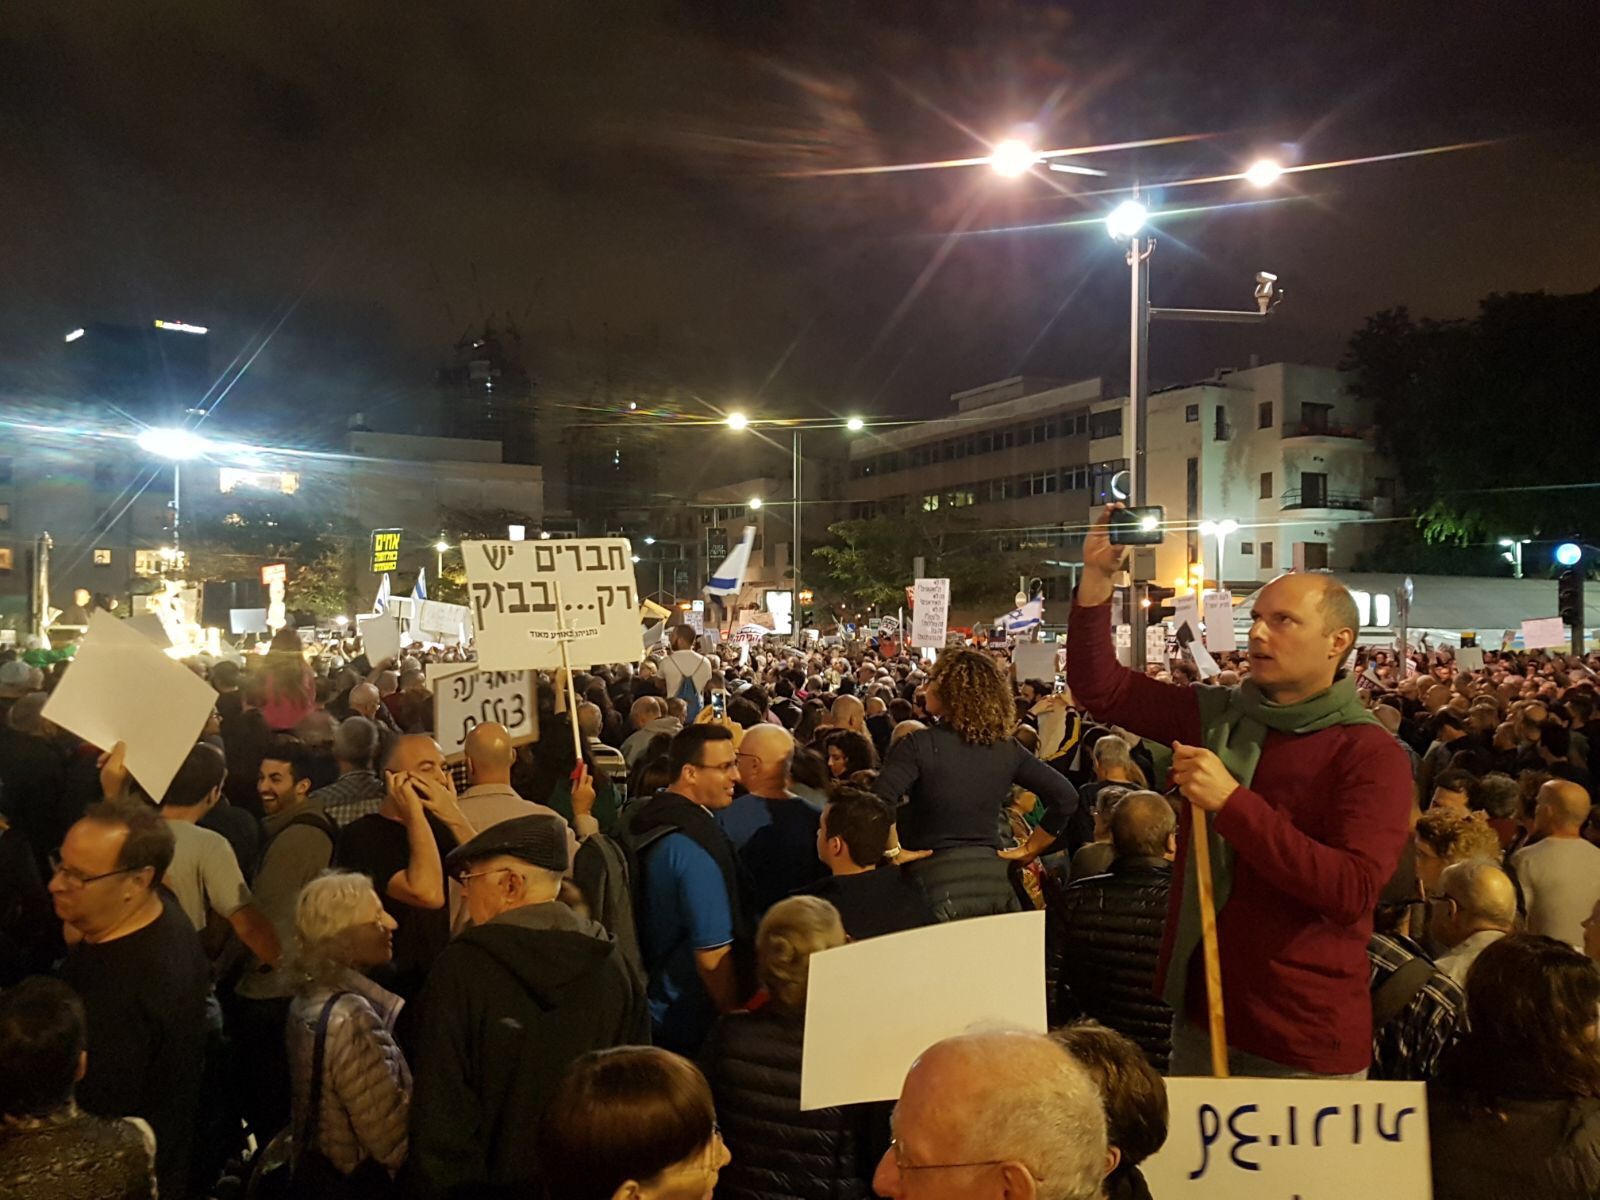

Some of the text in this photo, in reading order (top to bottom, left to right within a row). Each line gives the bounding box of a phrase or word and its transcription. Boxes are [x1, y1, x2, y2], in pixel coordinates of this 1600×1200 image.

[373, 533, 401, 550] אחים
[482, 544, 626, 572] חברים יש
[472, 581, 556, 631] בבזק
[529, 631, 549, 639] מאוד
[575, 628, 598, 637] נתניהו
[453, 670, 524, 702] המדינה
[1187, 1103, 1418, 1180] לציונות
